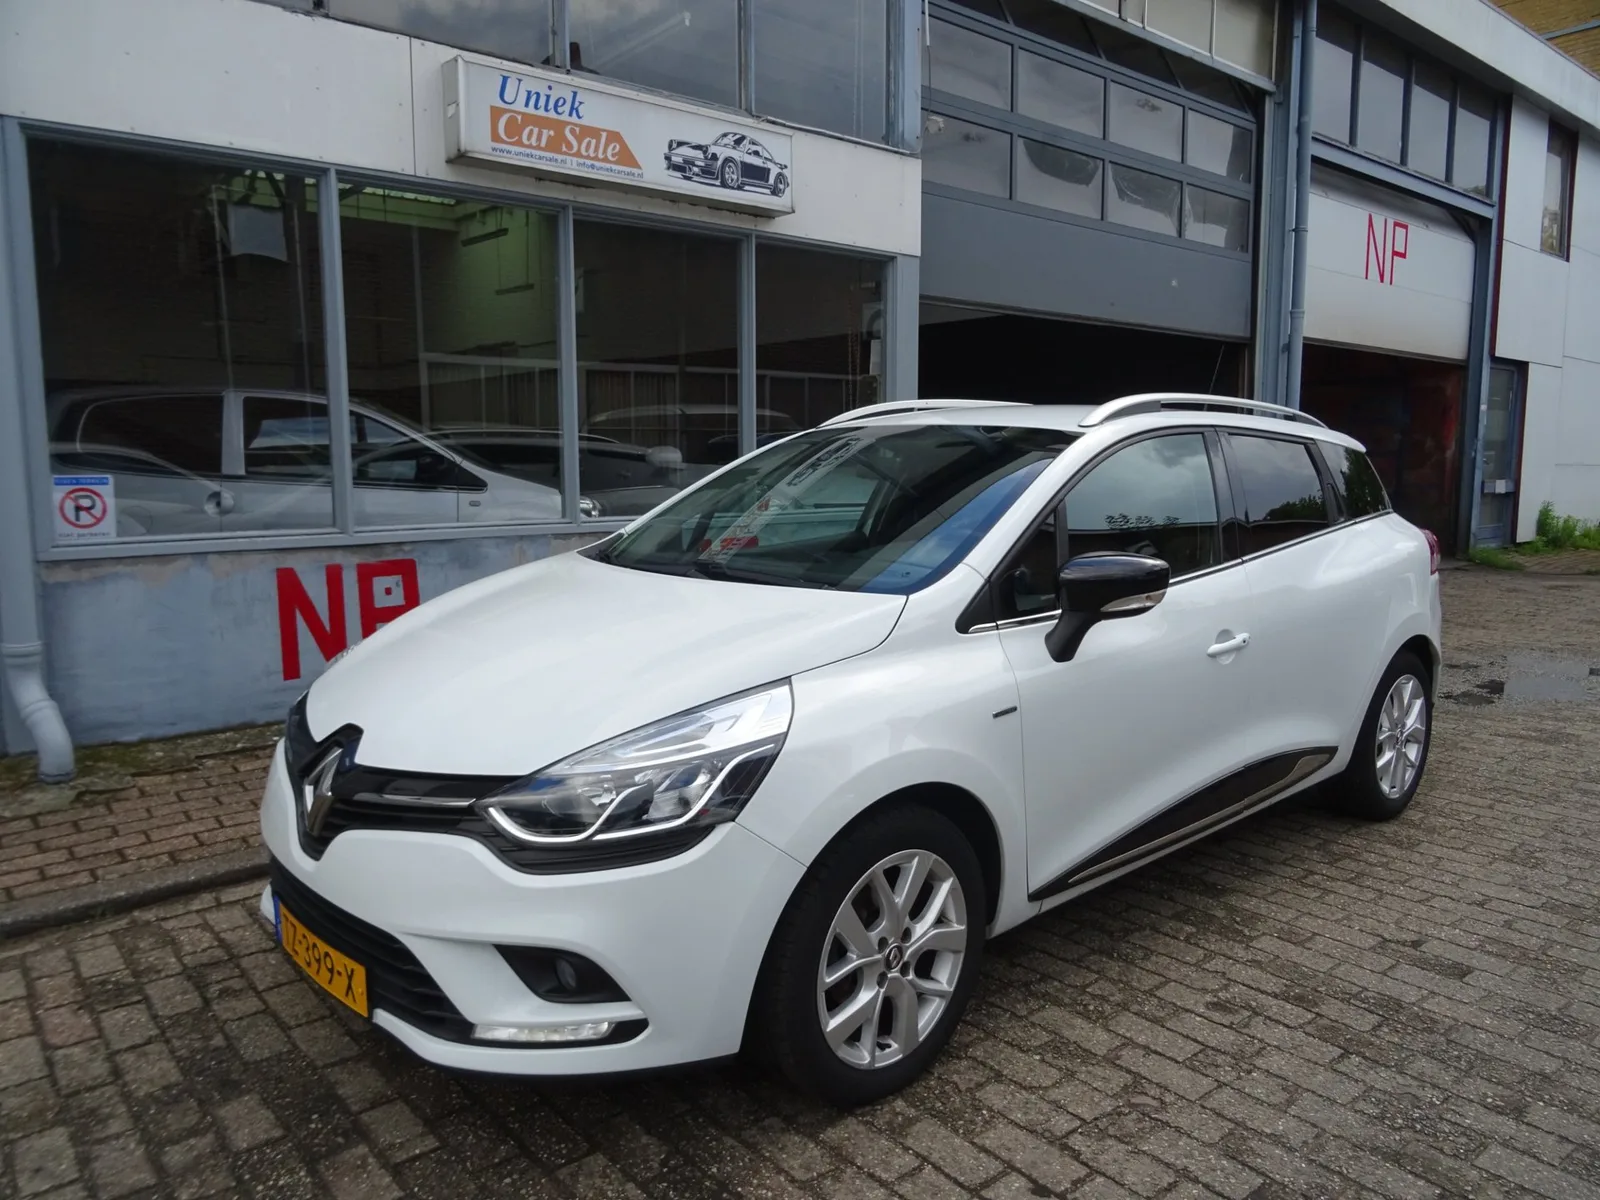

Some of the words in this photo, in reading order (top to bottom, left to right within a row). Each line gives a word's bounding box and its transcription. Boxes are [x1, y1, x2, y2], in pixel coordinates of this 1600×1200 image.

[498, 74, 585, 119] Uniek
[491, 146, 567, 165] www.uniekcarsale.nl
[497, 112, 554, 148] Car
[562, 125, 620, 161] Sale
[1365, 213, 1408, 285] NP
[276, 558, 420, 681] NP
[282, 911, 357, 1004] TZ-399-X
